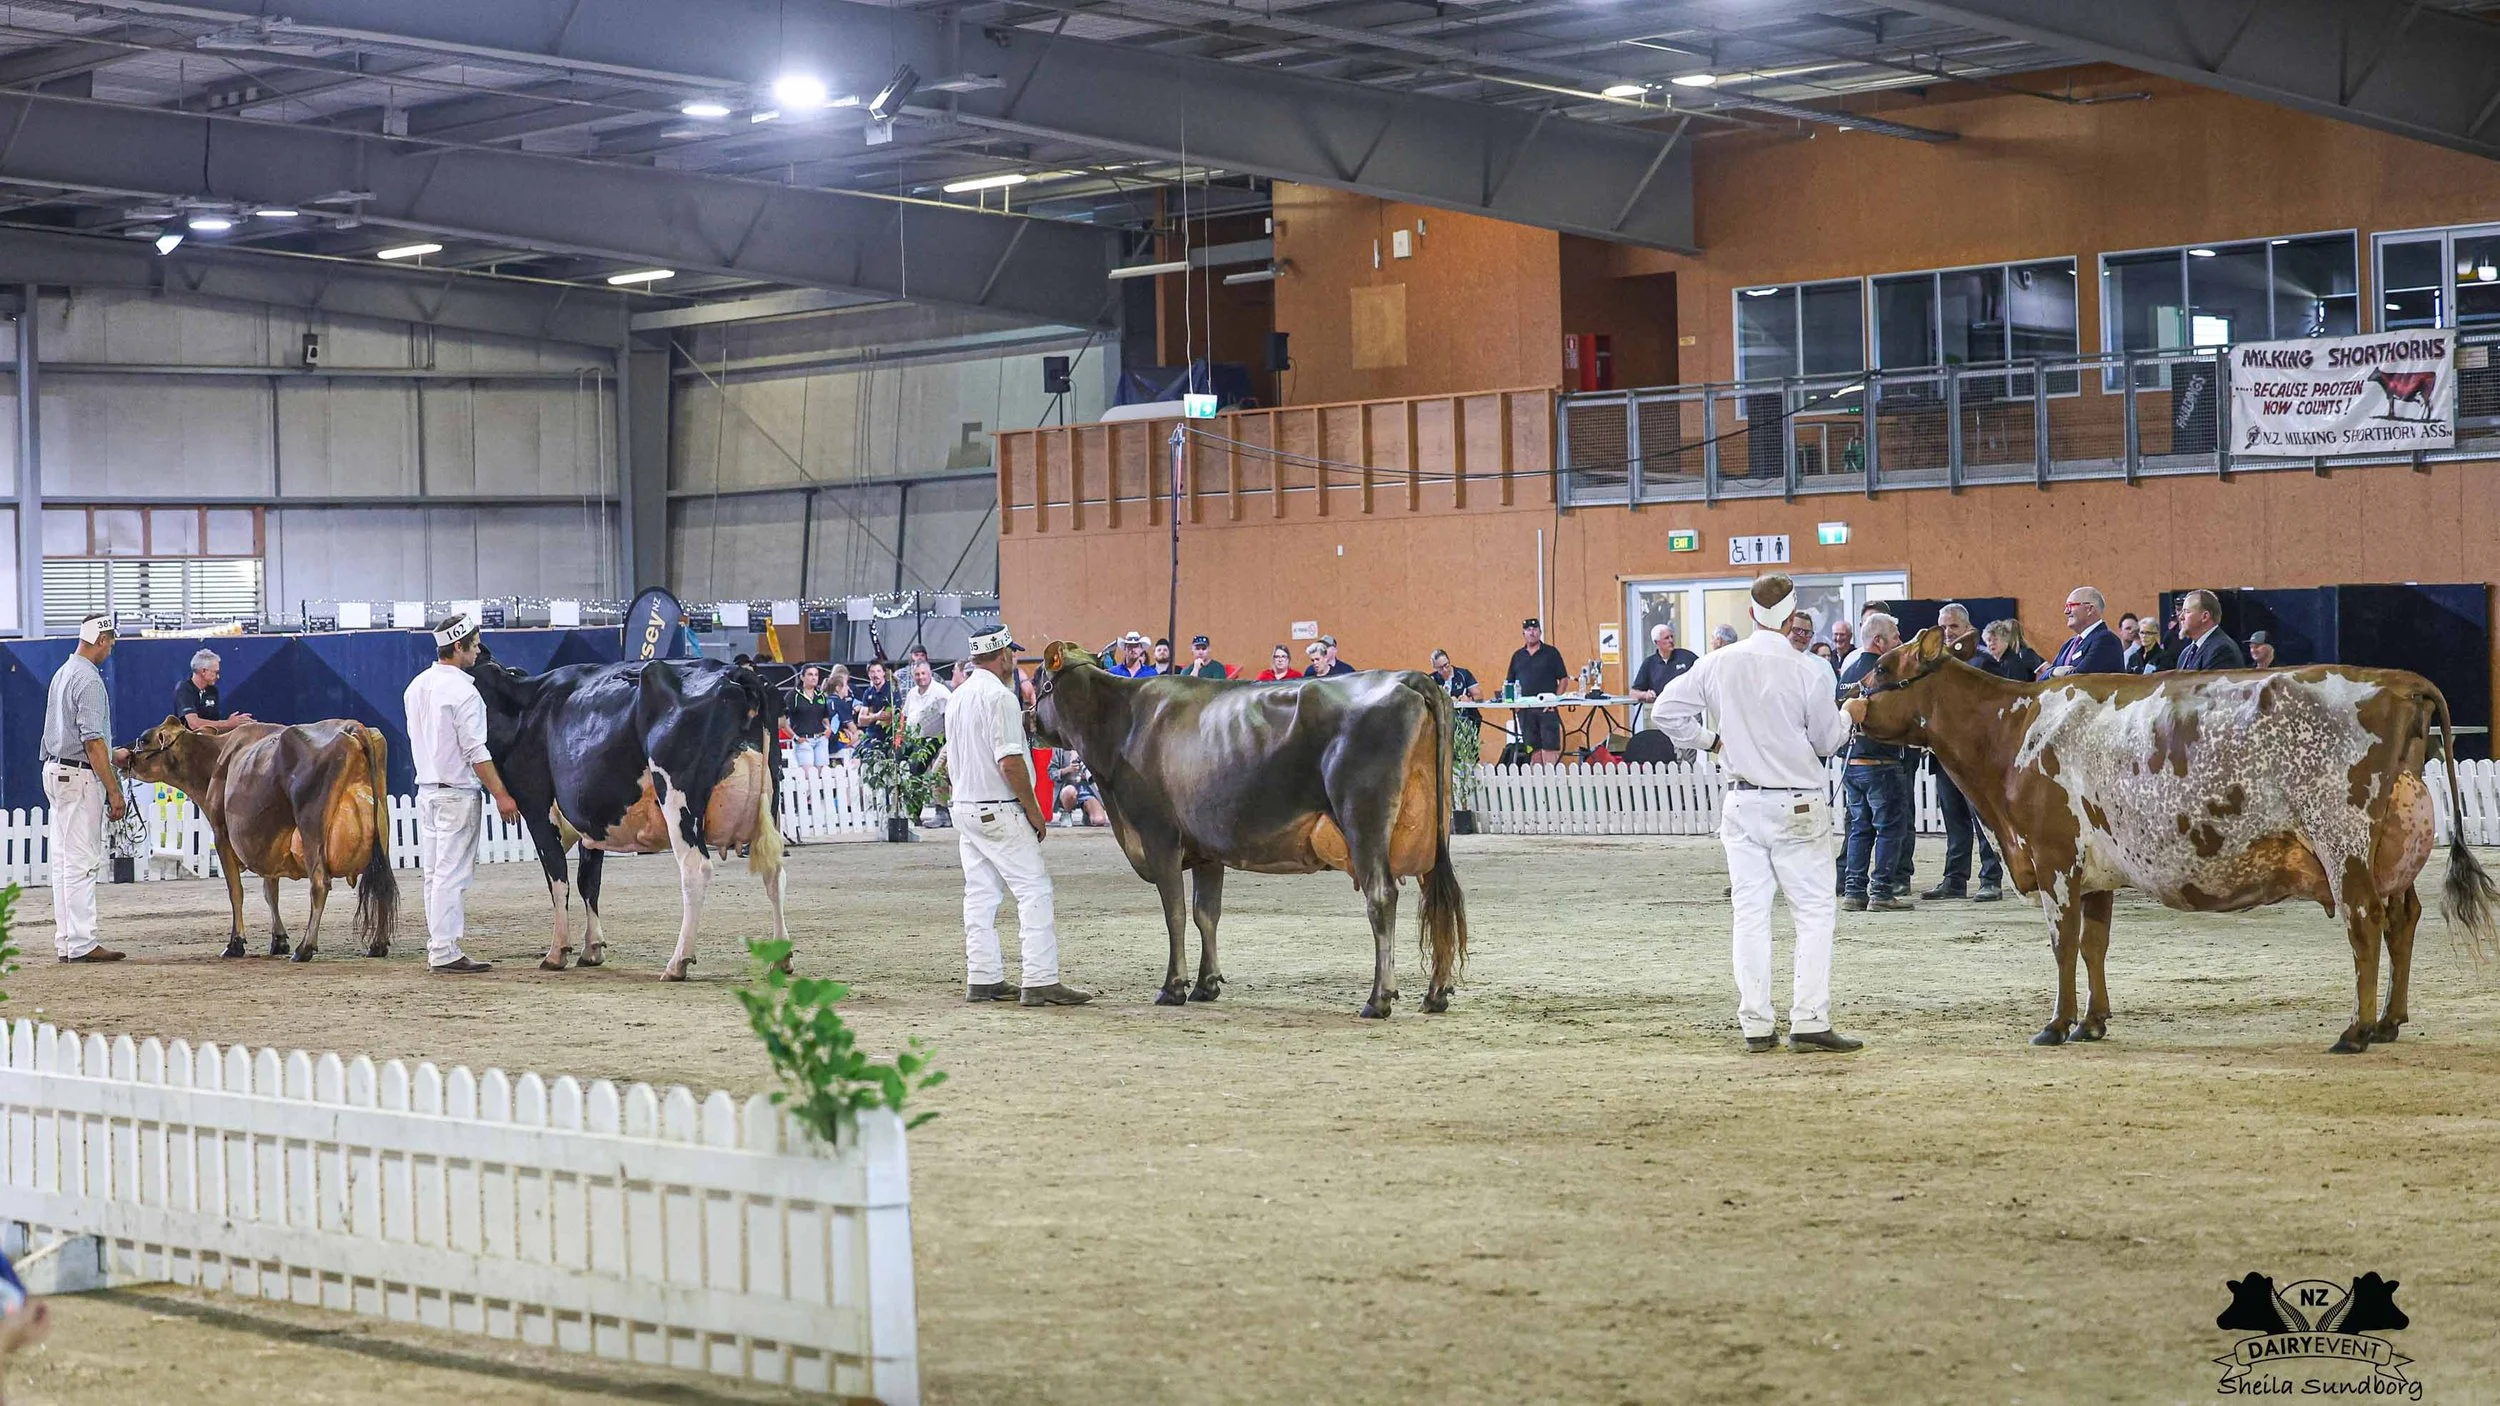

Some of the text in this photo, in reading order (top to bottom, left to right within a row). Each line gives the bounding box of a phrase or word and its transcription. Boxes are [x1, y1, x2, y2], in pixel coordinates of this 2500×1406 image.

[2241, 338, 2446, 369] MILKING SHORTHORNS
[2311, 379, 2365, 397] PROTEIN
[2262, 400, 2293, 416] NOW
[2284, 431, 2337, 445] MILKING
[2342, 426, 2416, 443] SHORTHORN
[1673, 537, 1689, 549] EXIT
[446, 624, 467, 640] 162
